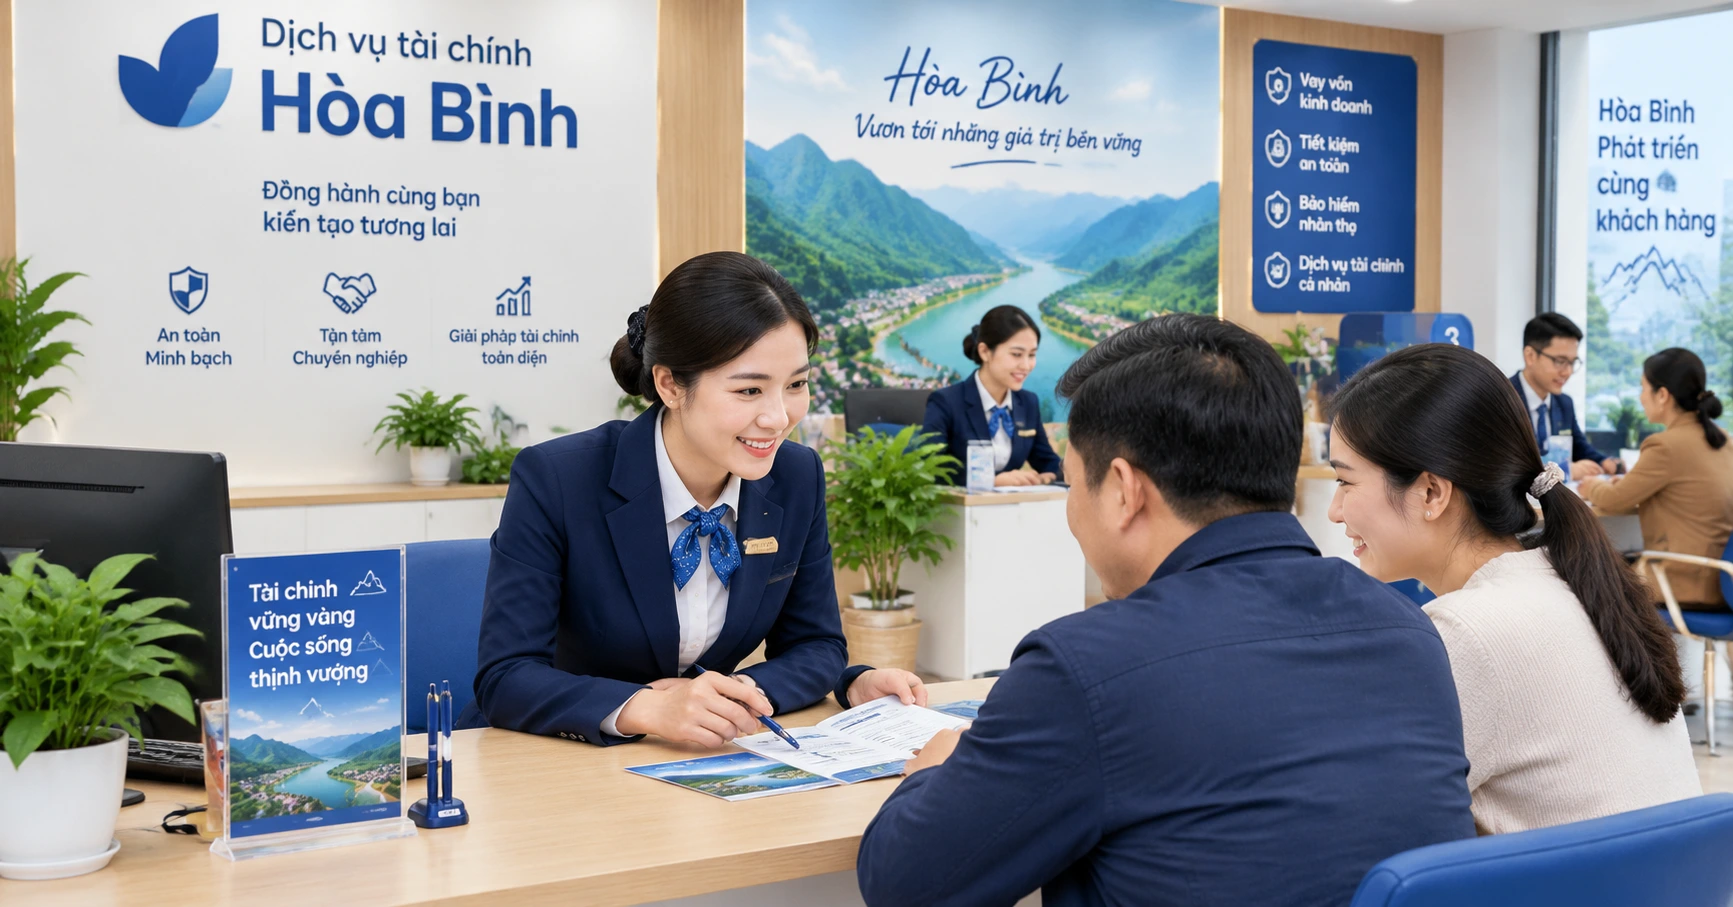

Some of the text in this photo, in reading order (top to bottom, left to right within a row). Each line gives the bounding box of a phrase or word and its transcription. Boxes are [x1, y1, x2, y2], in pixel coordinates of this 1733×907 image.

[262, 18, 531, 66] Dịch vụ tài chính
[884, 46, 1069, 109] Hòa Bình
[1300, 72, 1325, 92] Vay
[262, 69, 577, 148] Hòa Bình
[1300, 93, 1372, 114] kinh doanh
[1600, 97, 1641, 122] Hòa
[1040, 128, 1062, 153] trị
[1299, 159, 1316, 170] an
[262, 180, 479, 211] Đồng hành cùng bạn
[1597, 170, 1649, 201] cùng
[317, 215, 354, 238] tạo
[360, 216, 424, 241] tương
[433, 217, 456, 236] lai
[1335, 218, 1357, 236] thọ
[1665, 208, 1715, 238] hàng
[1299, 255, 1329, 274] Dịch
[1332, 260, 1348, 275] vụ
[157, 328, 179, 342] An
[146, 350, 232, 369] Minh bạch
[249, 582, 279, 602] Tài
[306, 607, 355, 628] vàng
[249, 666, 301, 690] thịnh
